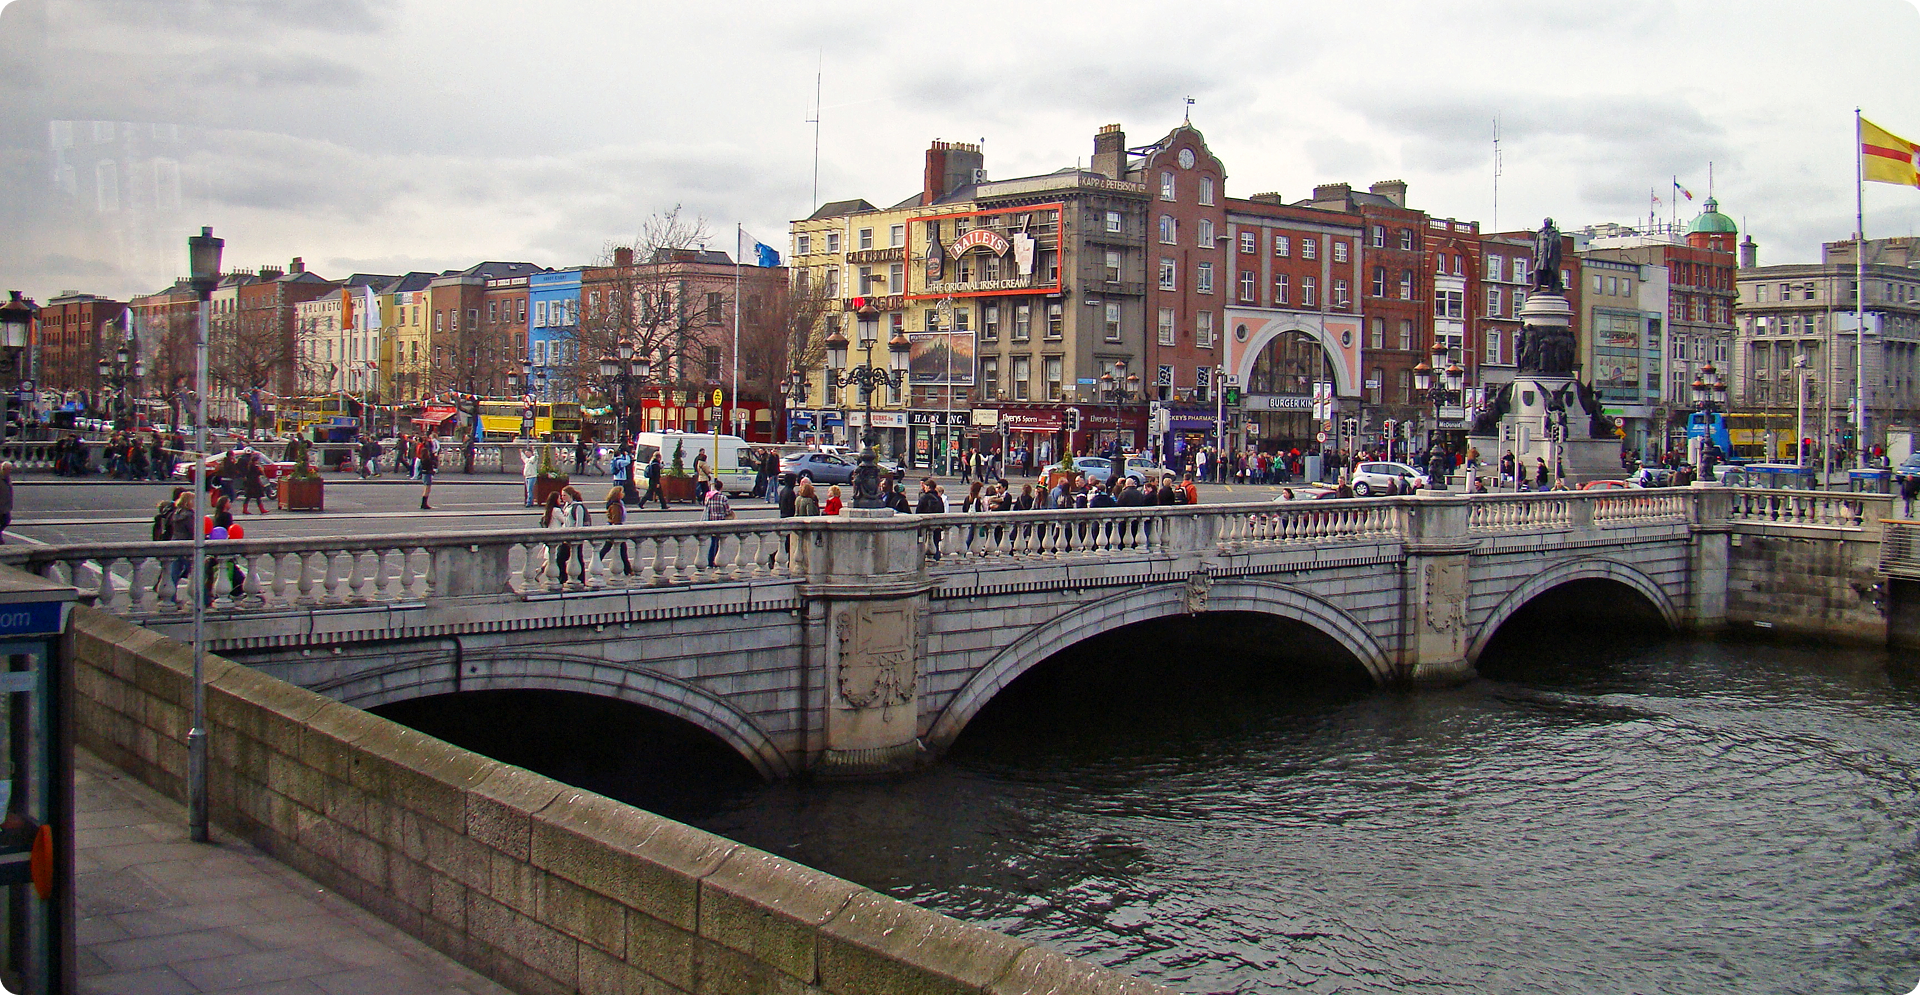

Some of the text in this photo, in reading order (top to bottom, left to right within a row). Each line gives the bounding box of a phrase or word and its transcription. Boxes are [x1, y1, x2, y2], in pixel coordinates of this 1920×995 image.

[1081, 176, 1100, 187] KAPP
[1106, 179, 1136, 192] PETERSON
[954, 232, 1005, 255] BAILEYS
[928, 279, 1028, 292] THE ORIGINAL IRISH CREAM
[303, 301, 341, 313] ARLINGTO
[843, 296, 904, 312] WDSOR
[1270, 398, 1314, 408] BURGER KIN
[945, 414, 965, 424] NC.
[1002, 413, 1022, 424] Elverys
[1090, 415, 1108, 424] Elverys
[0, 612, 31, 628] om
